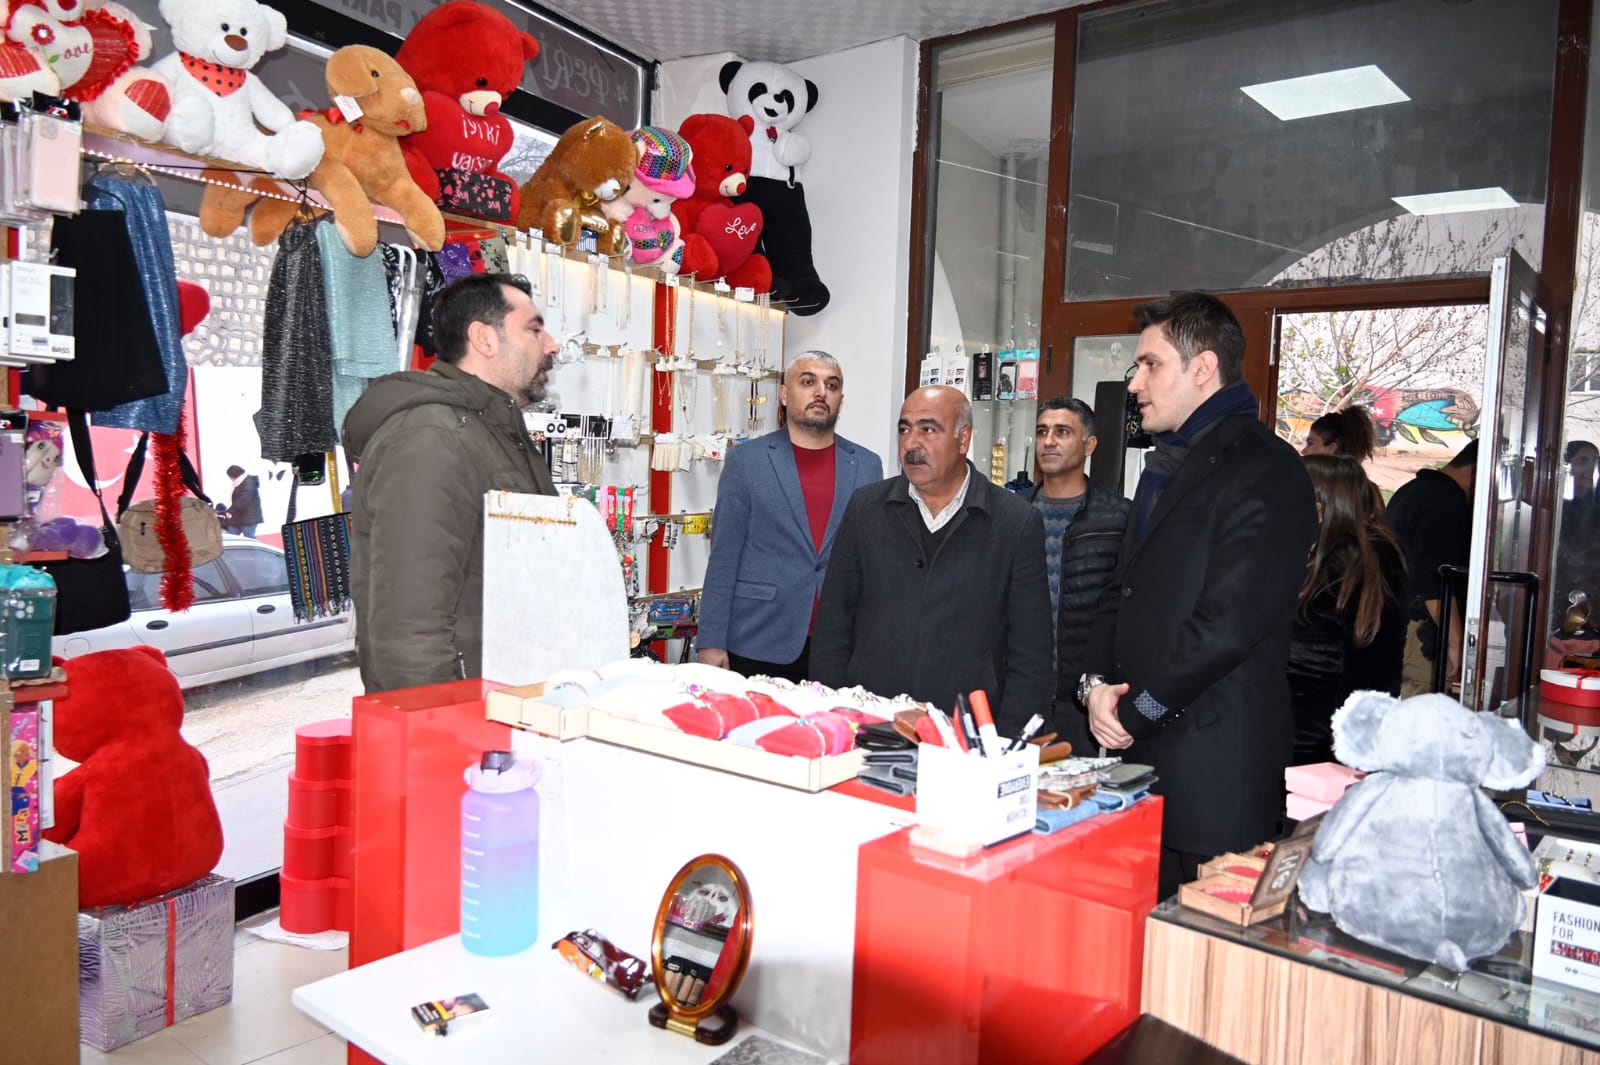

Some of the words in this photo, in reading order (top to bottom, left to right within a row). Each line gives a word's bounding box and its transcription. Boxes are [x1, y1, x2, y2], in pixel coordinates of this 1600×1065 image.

[725, 217, 757, 240] Love
[1552, 925, 1574, 940] FOR
[1553, 911, 1600, 933] FASHION
